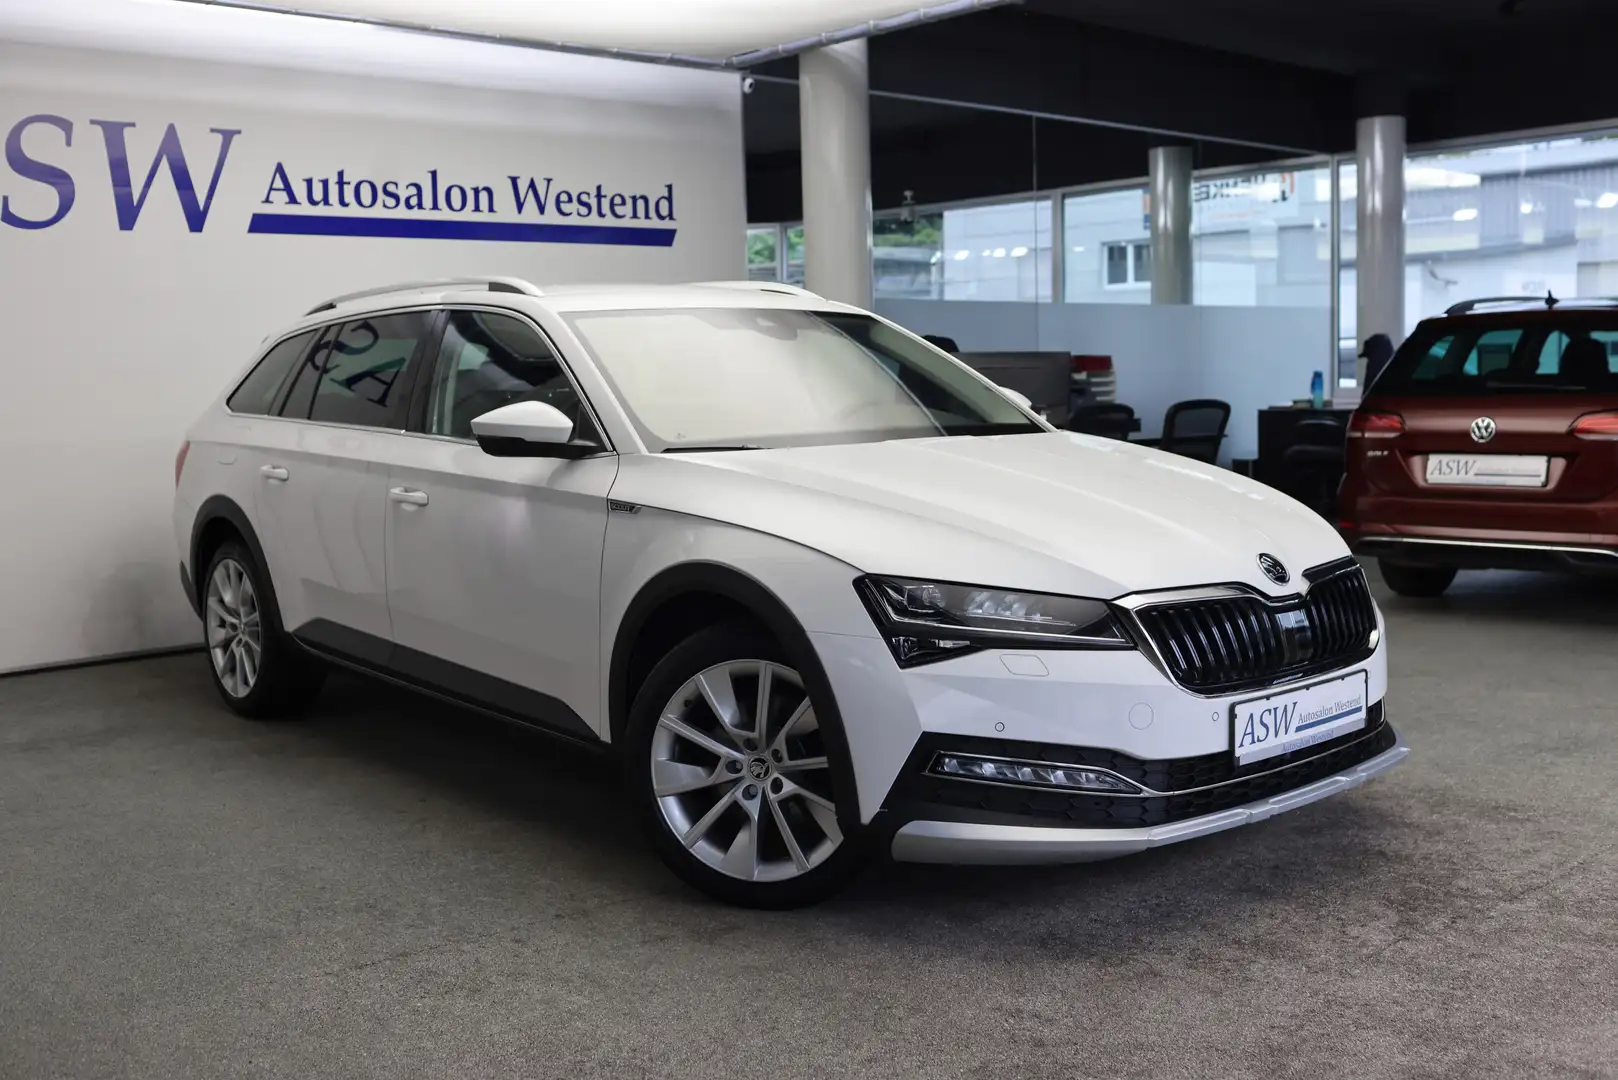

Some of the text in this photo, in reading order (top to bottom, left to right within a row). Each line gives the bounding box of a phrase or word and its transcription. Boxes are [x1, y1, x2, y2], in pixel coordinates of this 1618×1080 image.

[1, 114, 242, 233] SW
[261, 161, 677, 221] Autosalon Westend
[1430, 459, 1477, 476] ASW
[1238, 701, 1298, 748] ASW
[1298, 694, 1362, 724] Autosalon Westend
